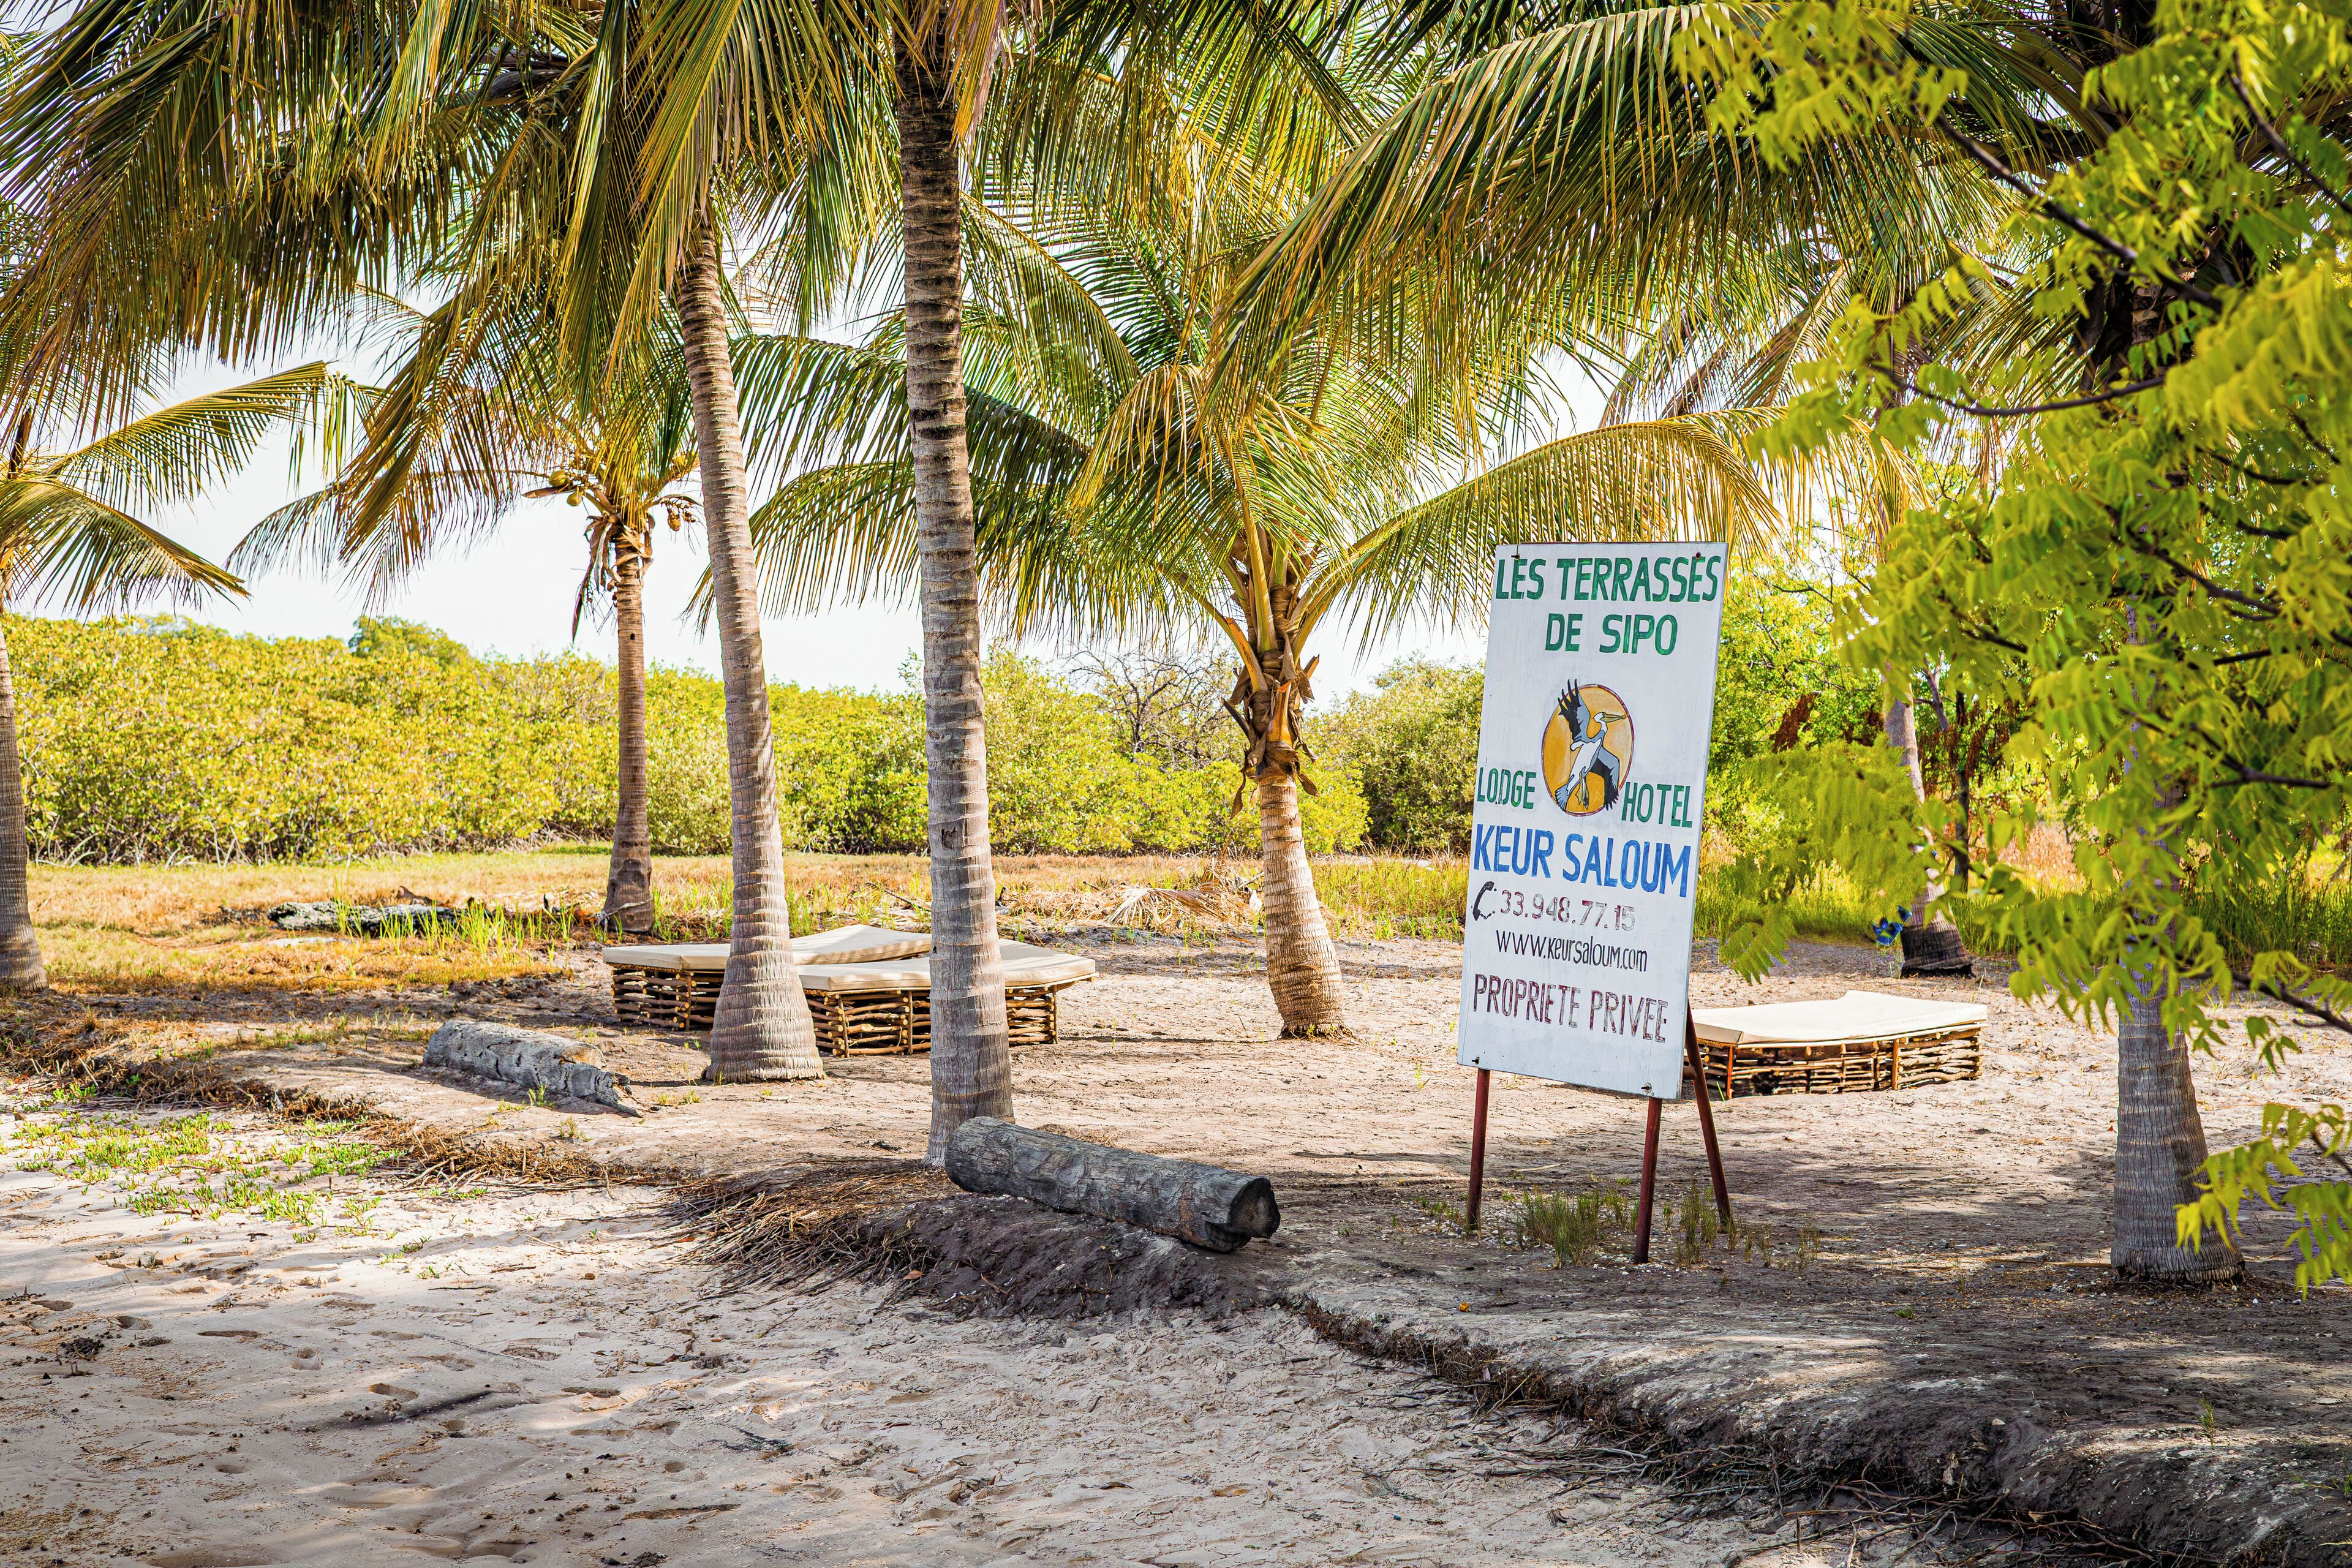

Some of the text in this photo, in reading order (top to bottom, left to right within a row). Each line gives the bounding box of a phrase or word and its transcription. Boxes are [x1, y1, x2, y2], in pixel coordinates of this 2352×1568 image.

[1496, 556, 1721, 602] LES TERRASSES
[1545, 613, 1678, 655] DE SIPO
[1477, 767, 1537, 809] LODGE
[1621, 782, 1693, 828] HOTEL
[1474, 824, 1691, 898] KEUR SALOUM
[1473, 973, 1669, 1043] PROPRIETE PRIVEE
